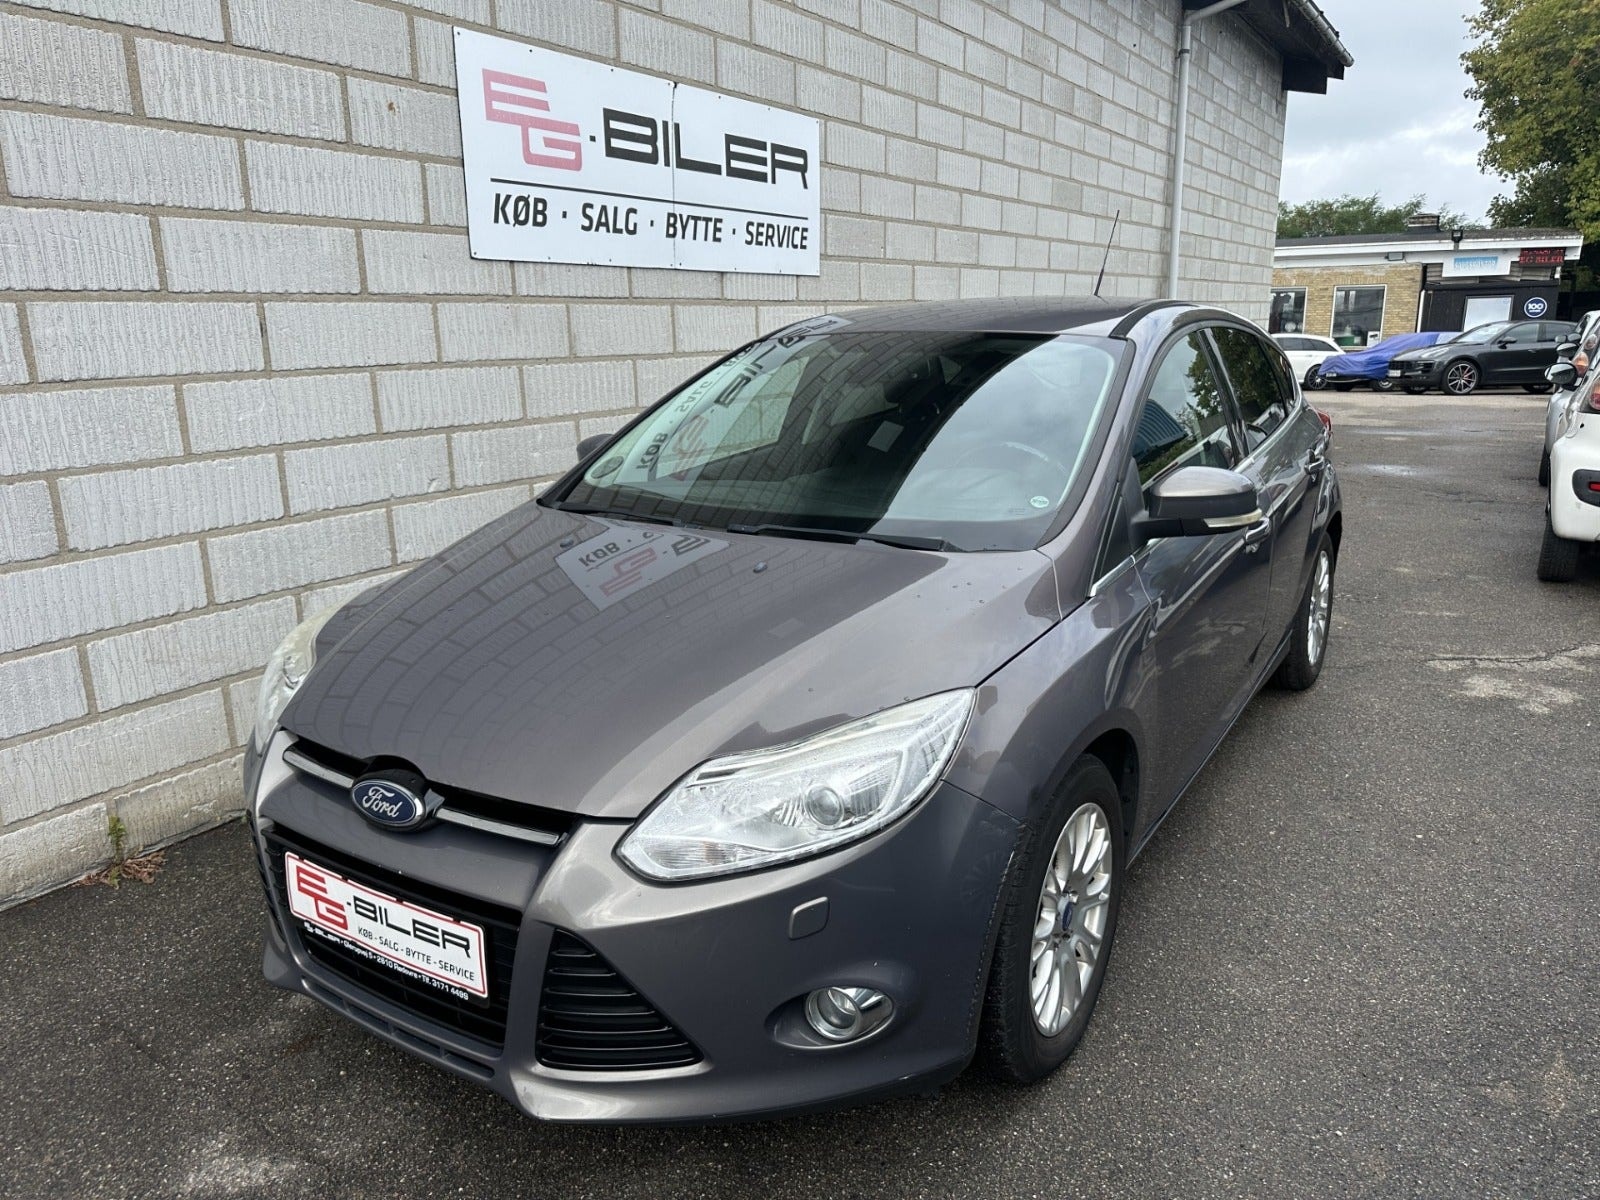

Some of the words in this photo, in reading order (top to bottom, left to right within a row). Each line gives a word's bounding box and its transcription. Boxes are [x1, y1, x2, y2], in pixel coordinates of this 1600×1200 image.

[493, 193, 548, 227] KØB
[580, 203, 638, 236] SALG
[665, 212, 723, 243] BYTTE
[744, 221, 809, 250] SERVICE
[362, 786, 402, 818] Ford
[357, 925, 373, 940] KØB
[379, 936, 399, 951] SALG
[406, 947, 431, 965] BYTTE
[438, 960, 475, 981] SERVICE
